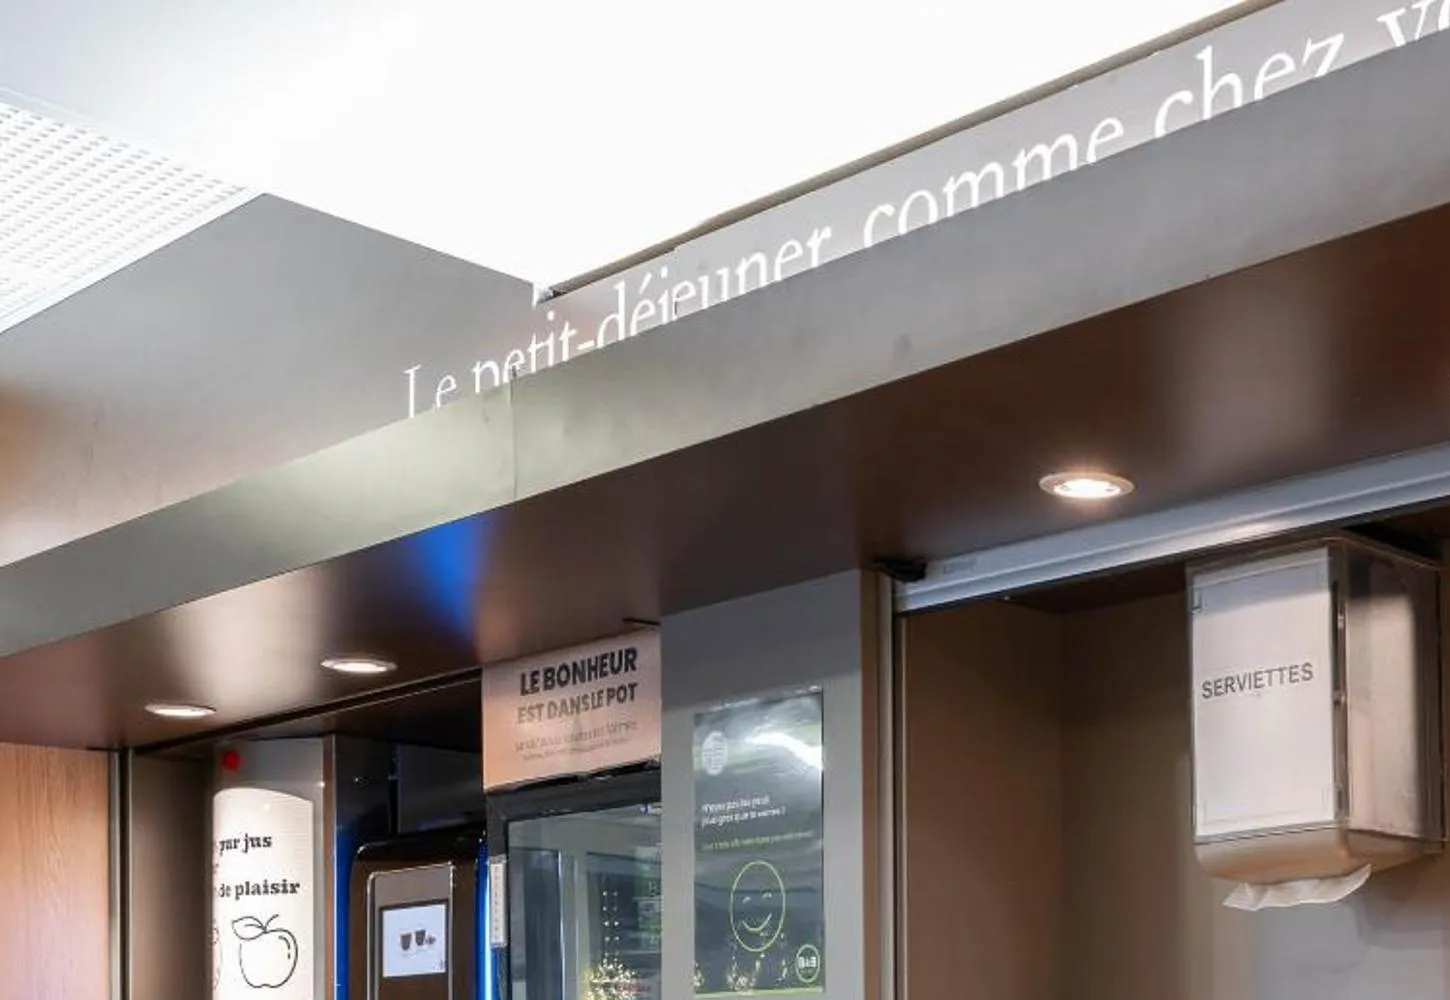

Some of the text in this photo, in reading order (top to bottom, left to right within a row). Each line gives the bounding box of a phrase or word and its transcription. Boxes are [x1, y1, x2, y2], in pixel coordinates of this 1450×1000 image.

[403, 363, 458, 418] Le
[863, 117, 1125, 248] comme
[1153, 33, 1345, 138] chez
[520, 647, 638, 696] LE BONHEUR
[1202, 661, 1314, 699] SERVIETTES
[517, 682, 638, 724] EST DANS LE POT
[241, 832, 273, 854] jus
[235, 878, 301, 901] plaisir
